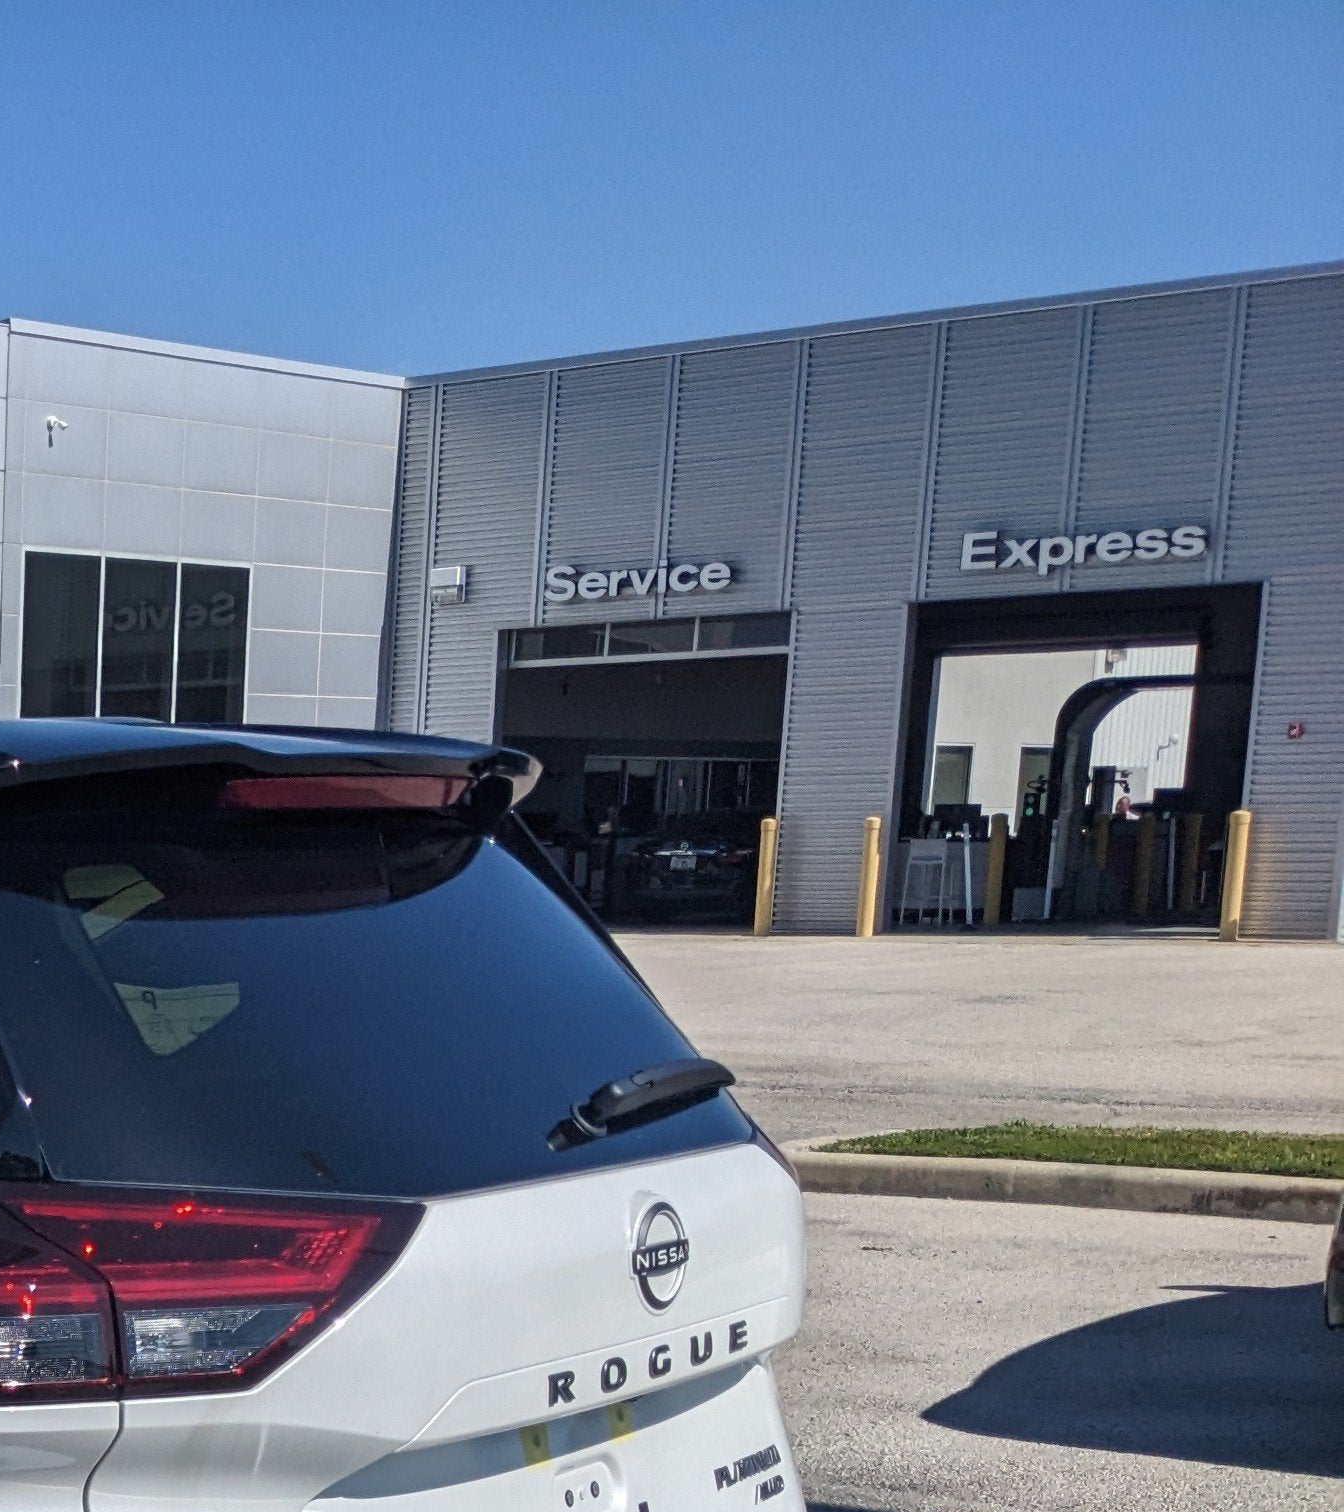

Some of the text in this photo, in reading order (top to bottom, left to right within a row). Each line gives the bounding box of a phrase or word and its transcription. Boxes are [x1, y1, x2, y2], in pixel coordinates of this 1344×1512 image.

[960, 525, 1208, 577] Express
[544, 558, 731, 602] Service
[547, 1319, 749, 1408] ROGUE
